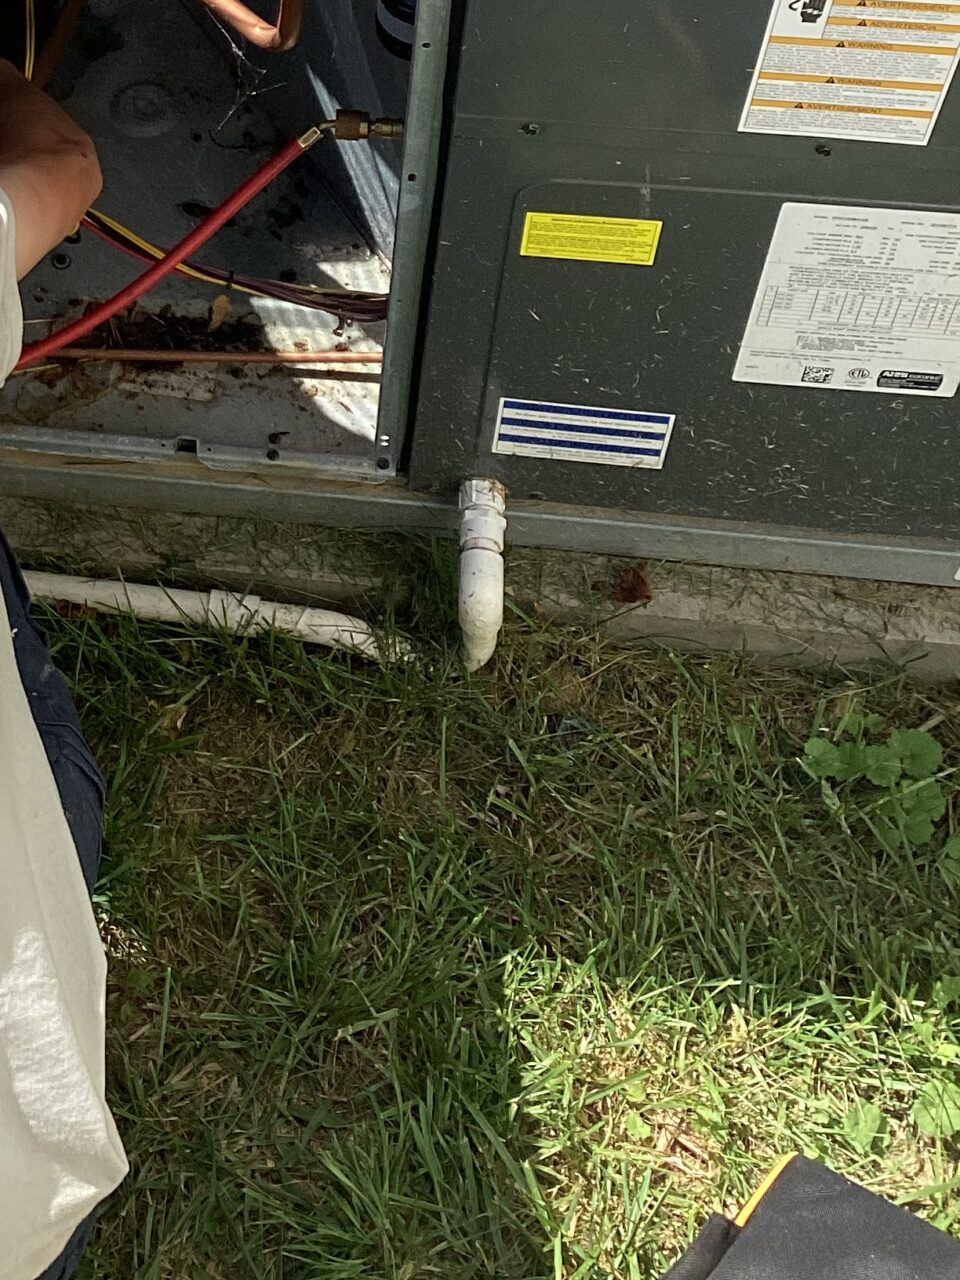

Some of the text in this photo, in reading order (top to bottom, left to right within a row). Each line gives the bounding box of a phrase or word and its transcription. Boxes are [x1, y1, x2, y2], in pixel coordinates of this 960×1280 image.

[870, 0, 950, 11] AVERTISSEMENT
[870, 21, 937, 30] ADVERTENCIA
[847, 41, 893, 50] WARNING
[837, 77, 882, 86] WARNING
[807, 103, 882, 114] AVERTISSEMENT
